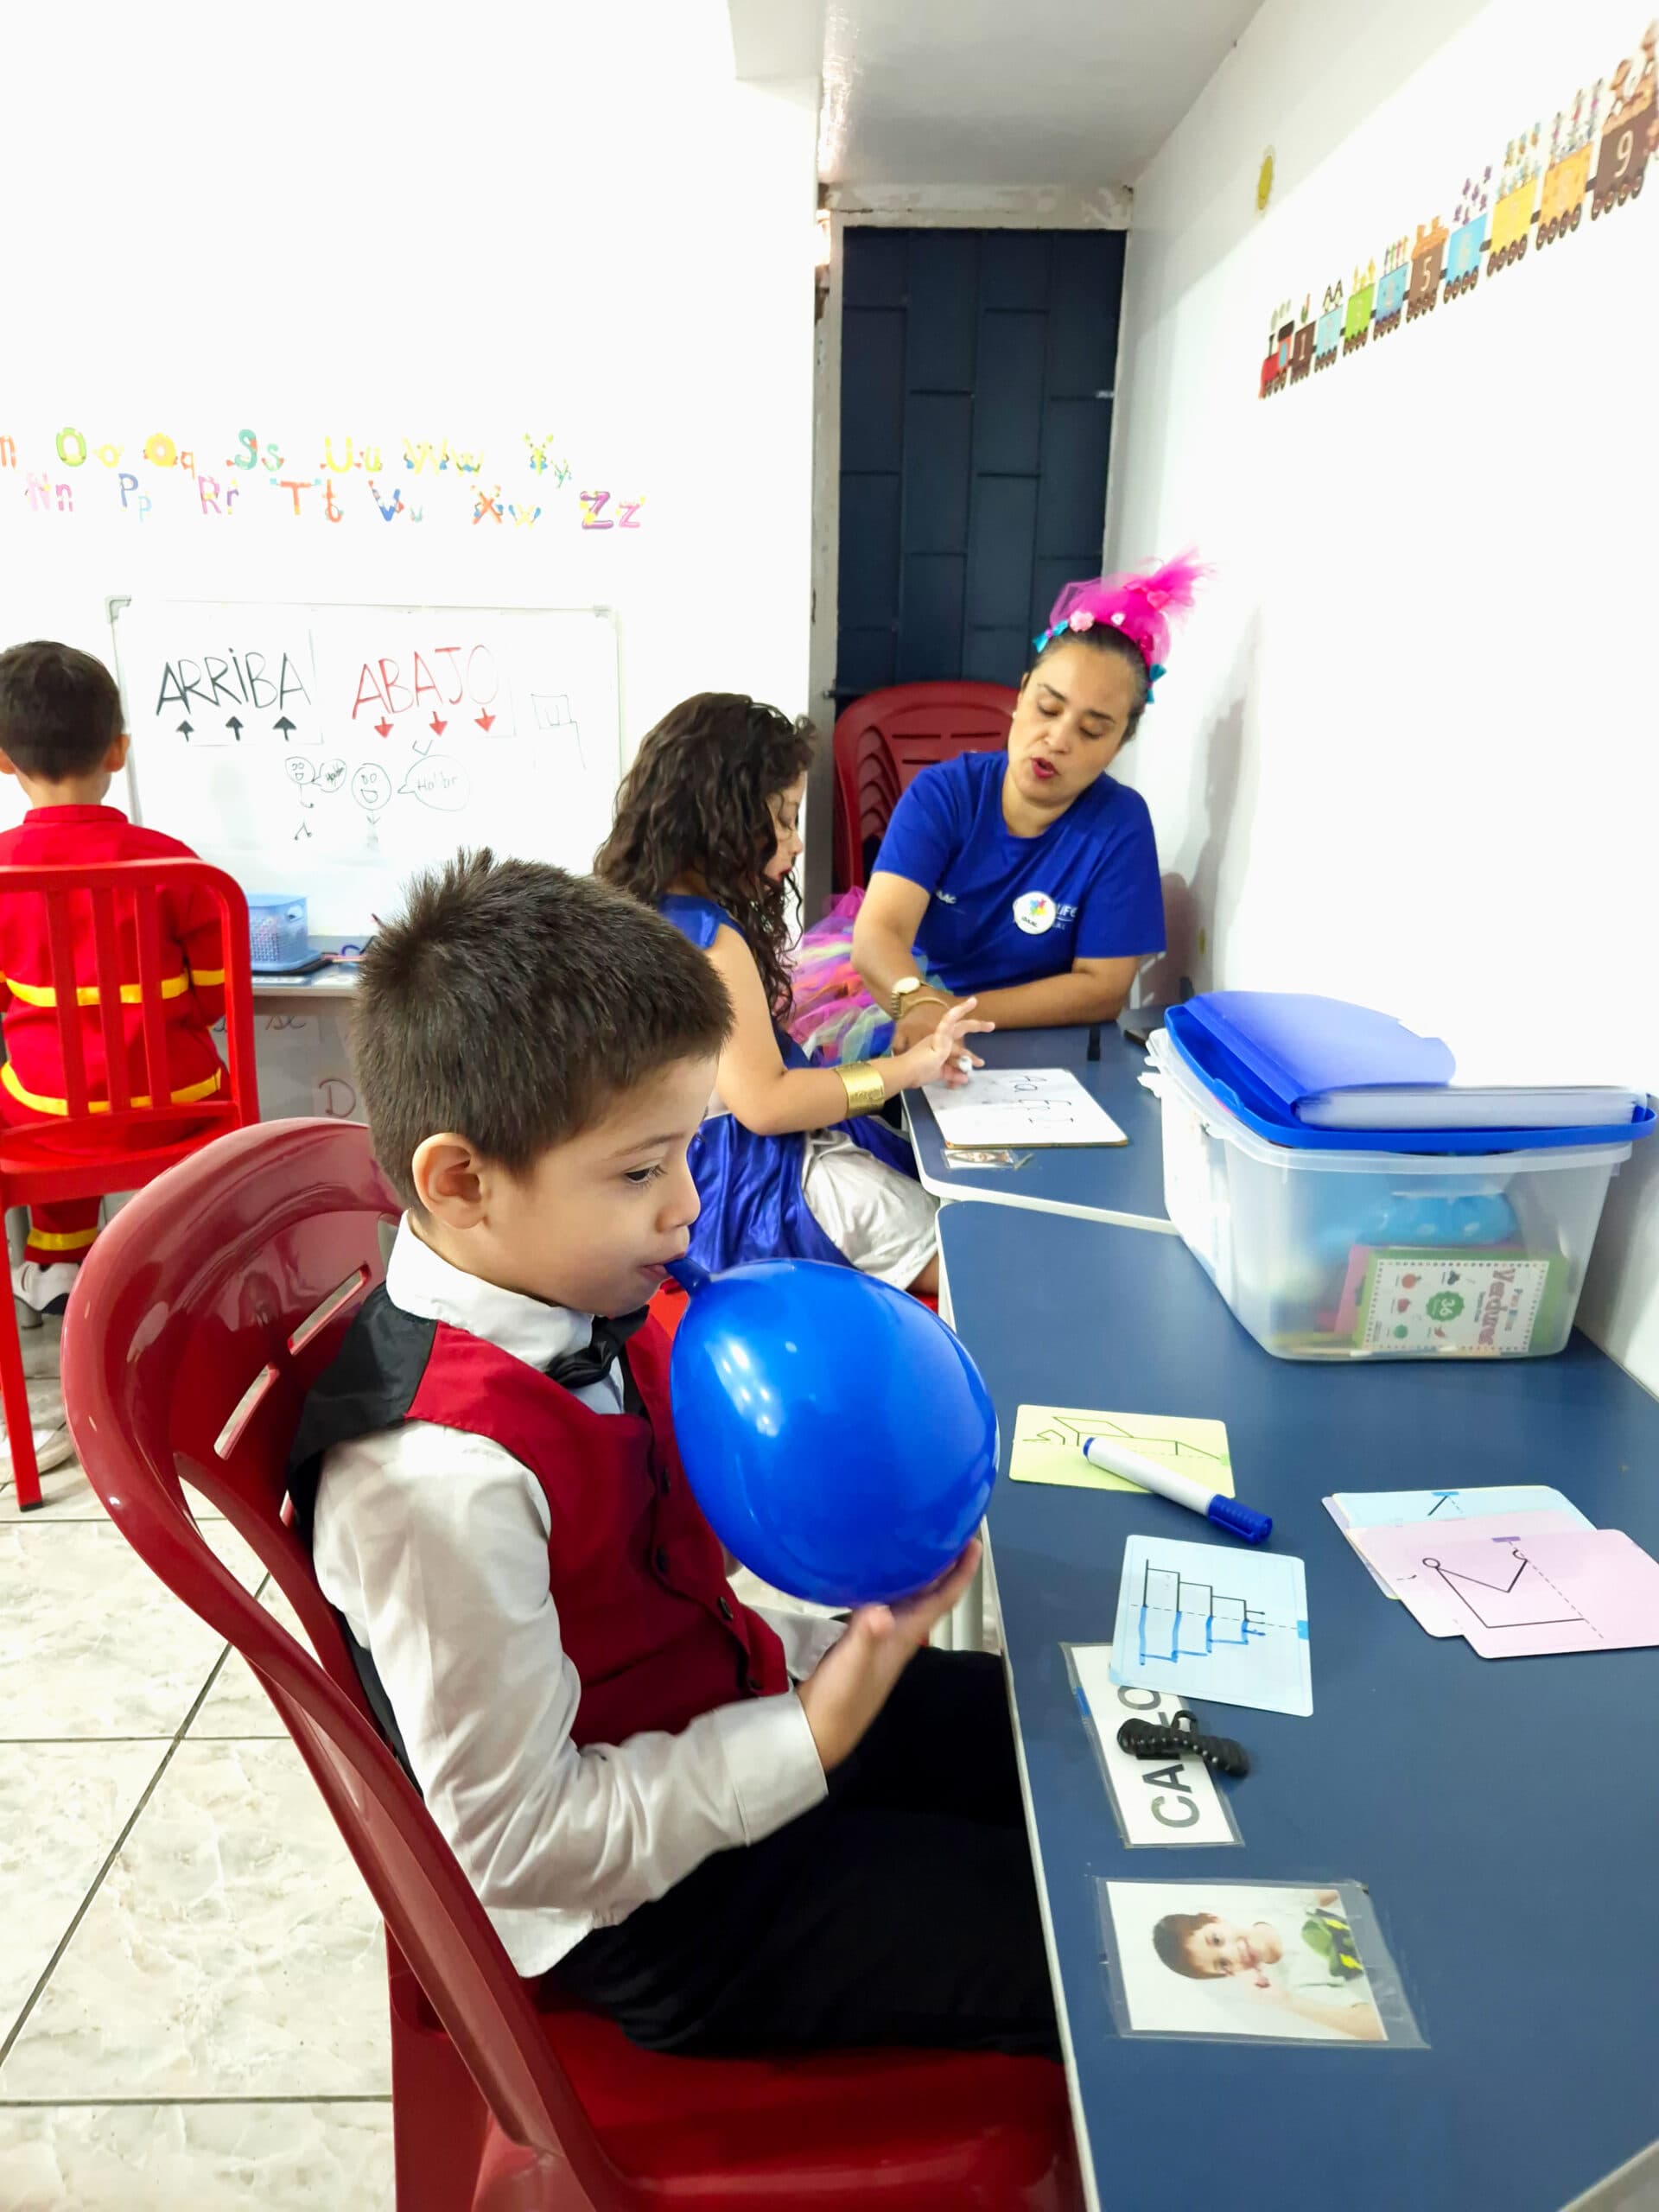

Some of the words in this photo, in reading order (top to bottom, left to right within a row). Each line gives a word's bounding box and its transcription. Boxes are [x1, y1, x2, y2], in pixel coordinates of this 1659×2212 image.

[1420, 255, 1433, 292] 5
[1613, 130, 1634, 178] 9
[352, 645, 499, 720] ABAJO
[1439, 1298, 1456, 1317] 36
